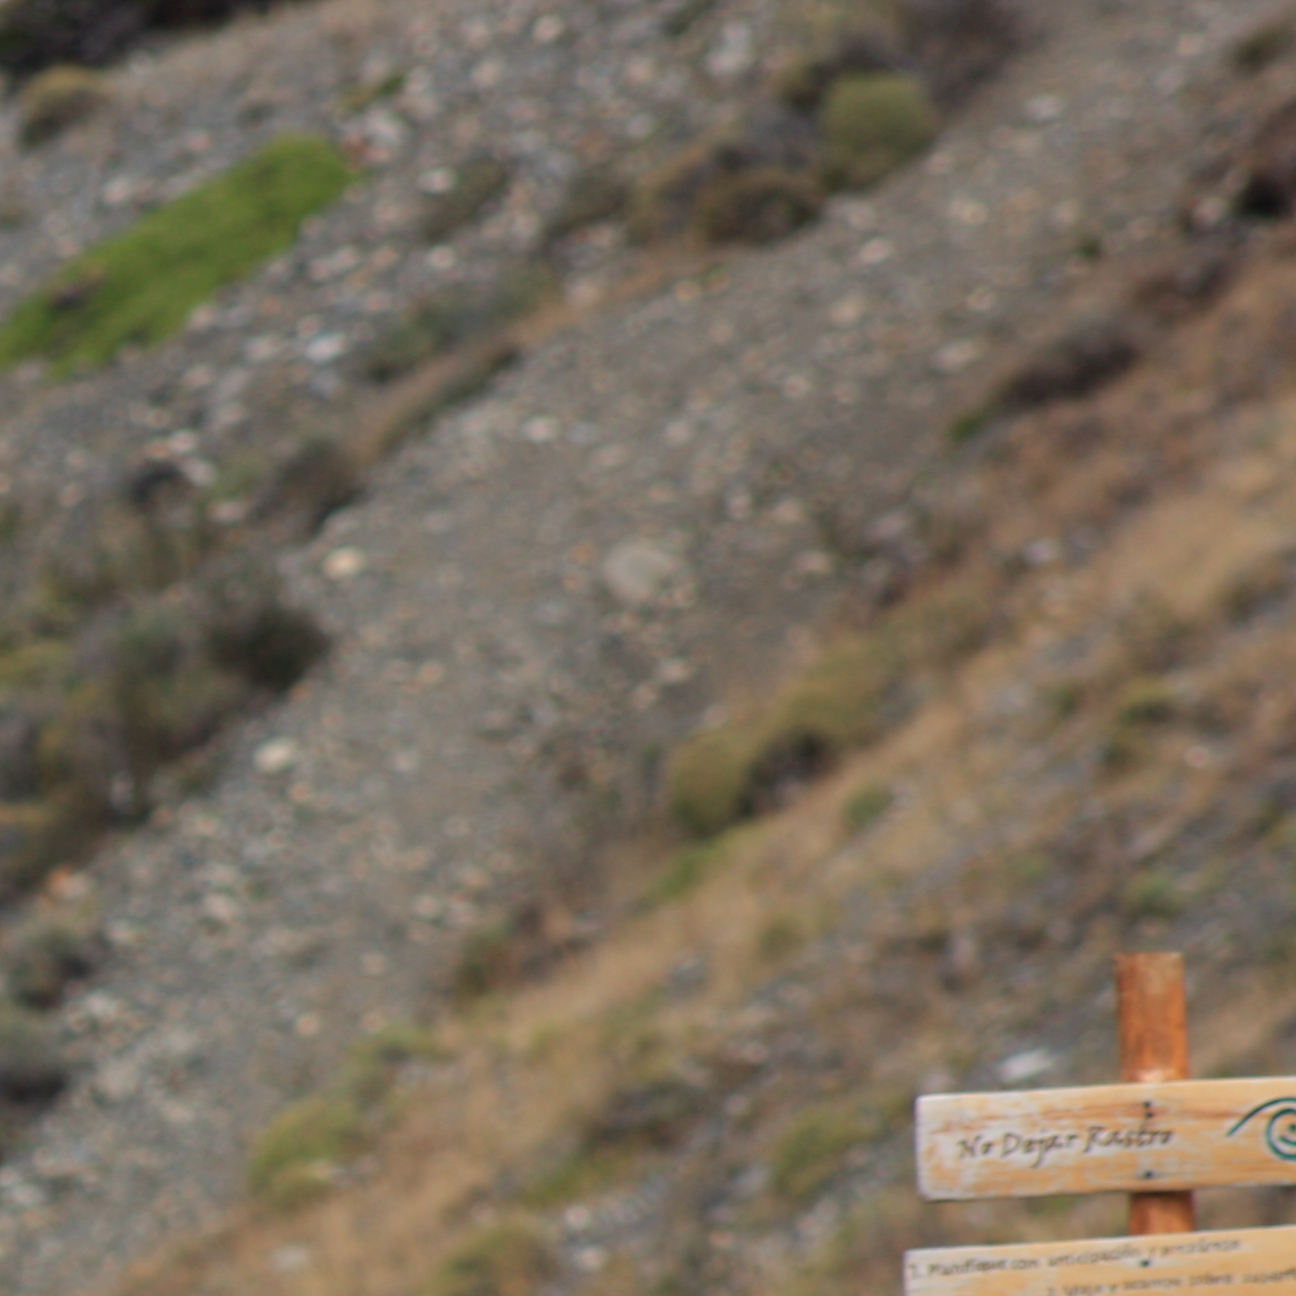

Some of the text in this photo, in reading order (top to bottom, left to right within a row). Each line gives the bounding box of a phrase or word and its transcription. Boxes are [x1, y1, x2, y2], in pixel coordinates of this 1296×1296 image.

[956, 1123, 1176, 1169] No Dejar Rastro
